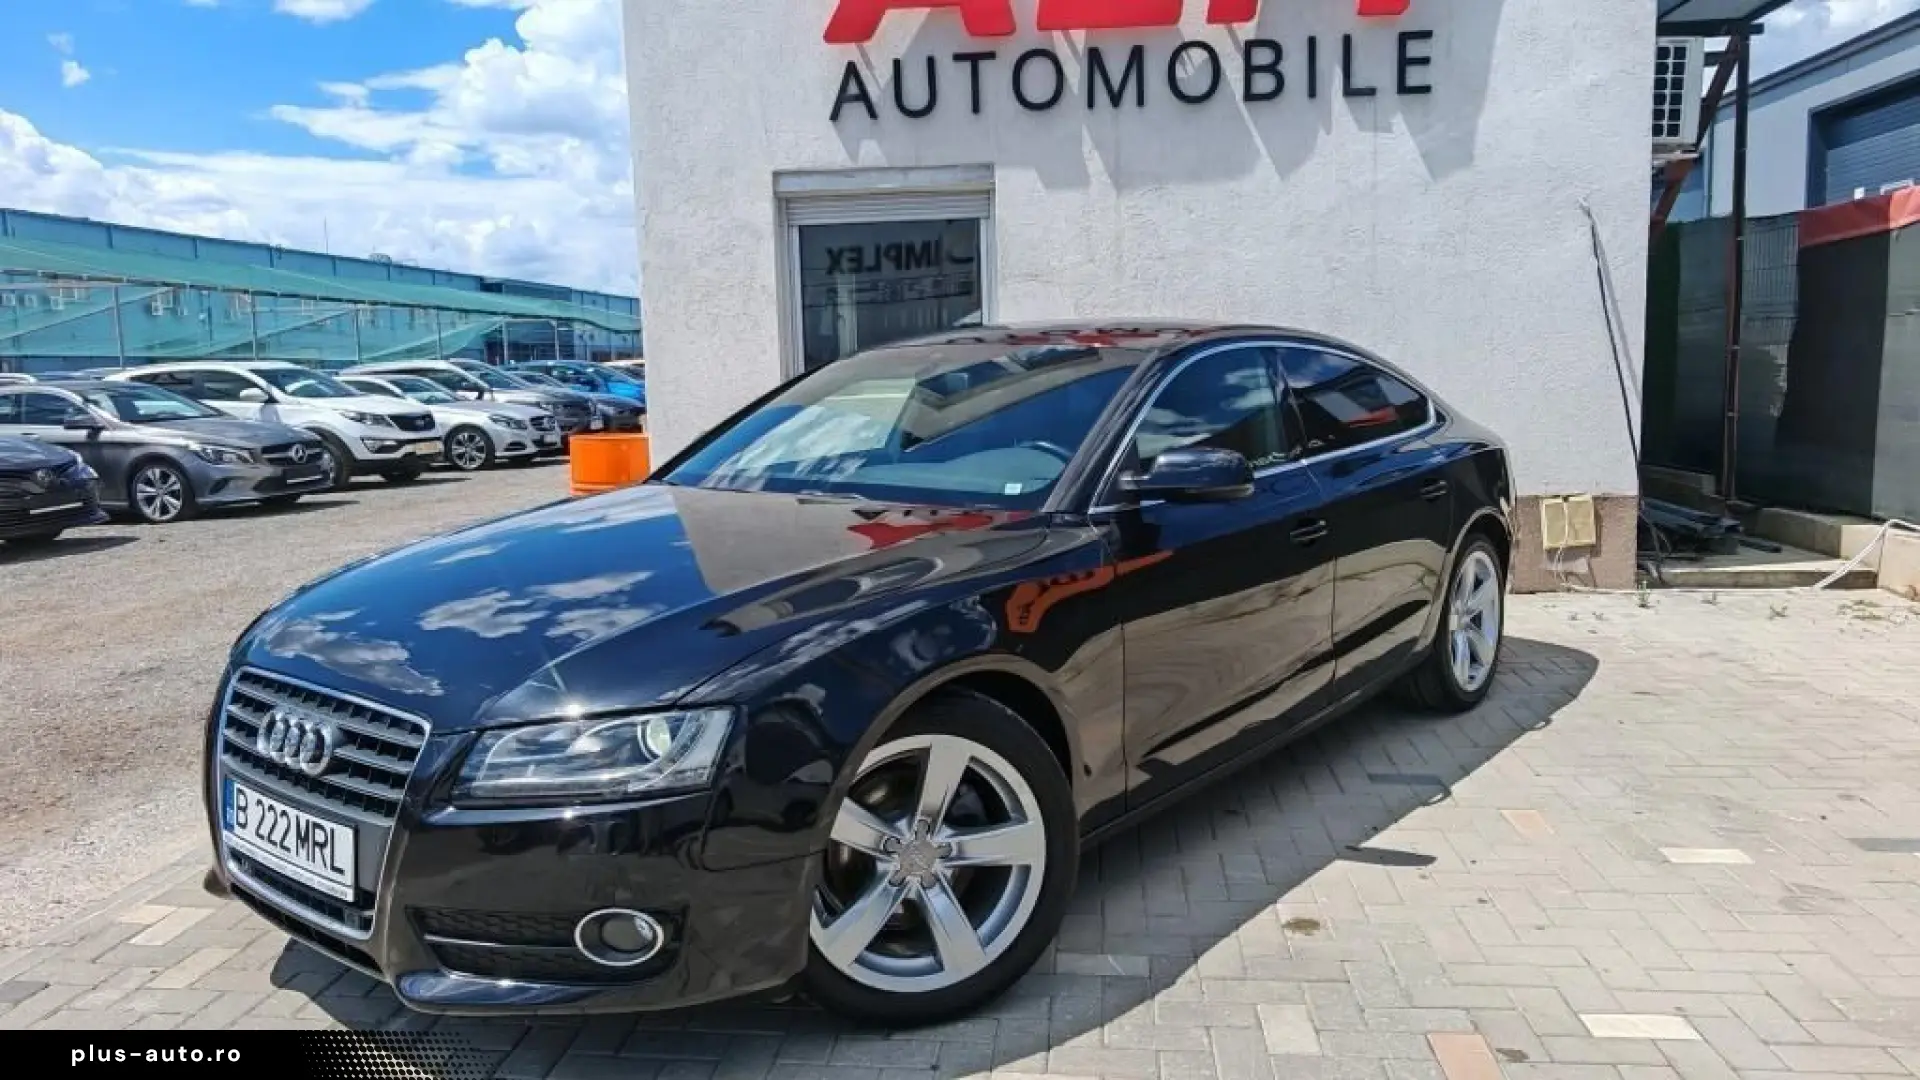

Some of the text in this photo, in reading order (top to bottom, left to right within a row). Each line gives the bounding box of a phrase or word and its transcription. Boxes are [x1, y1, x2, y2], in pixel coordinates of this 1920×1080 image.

[829, 30, 1434, 122] AUTOMOBILE
[236, 788, 249, 830] B
[255, 798, 292, 853] 222
[295, 815, 345, 875] MRL
